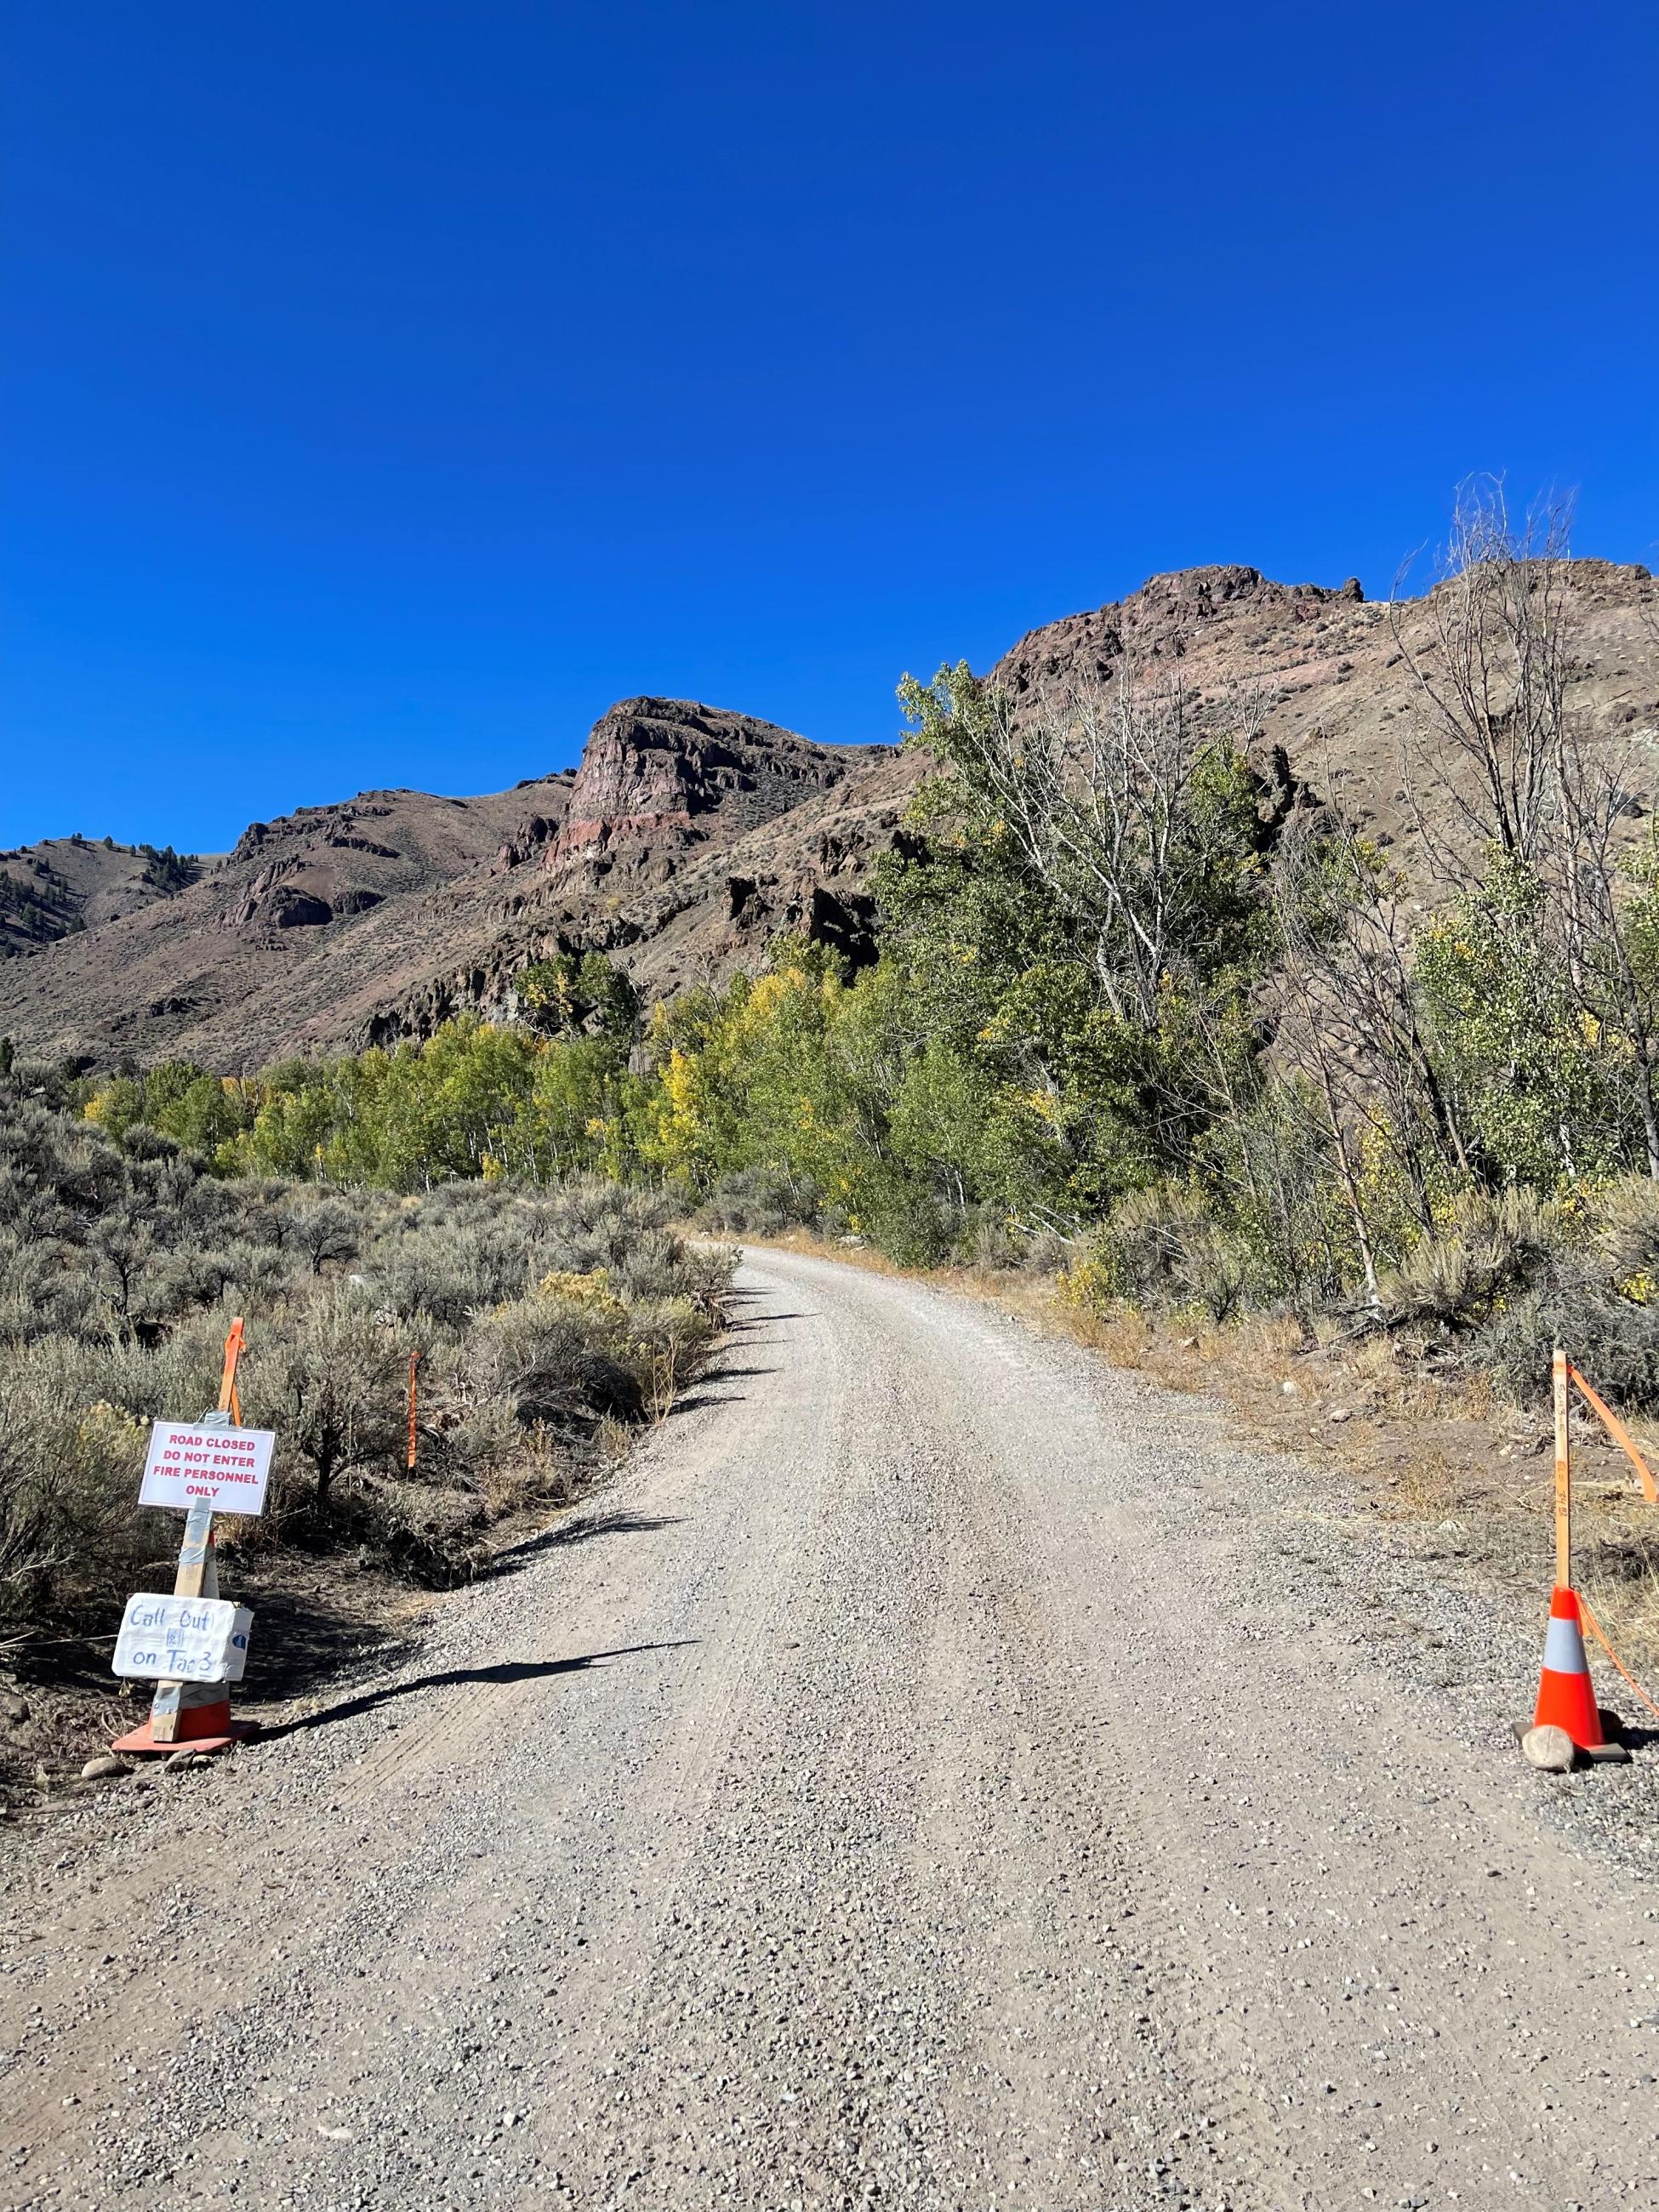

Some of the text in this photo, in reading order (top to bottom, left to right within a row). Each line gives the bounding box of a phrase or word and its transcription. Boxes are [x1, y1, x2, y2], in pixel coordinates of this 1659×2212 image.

[169, 1434, 255, 1451] ROAD CLOSED
[163, 1450, 255, 1468] DO NOT ENTER
[153, 1465, 259, 1485] FIRE PERSONNEL
[185, 1485, 220, 1497] ONLY
[130, 1605, 209, 1631] Call Out
[133, 1651, 157, 1665] on
